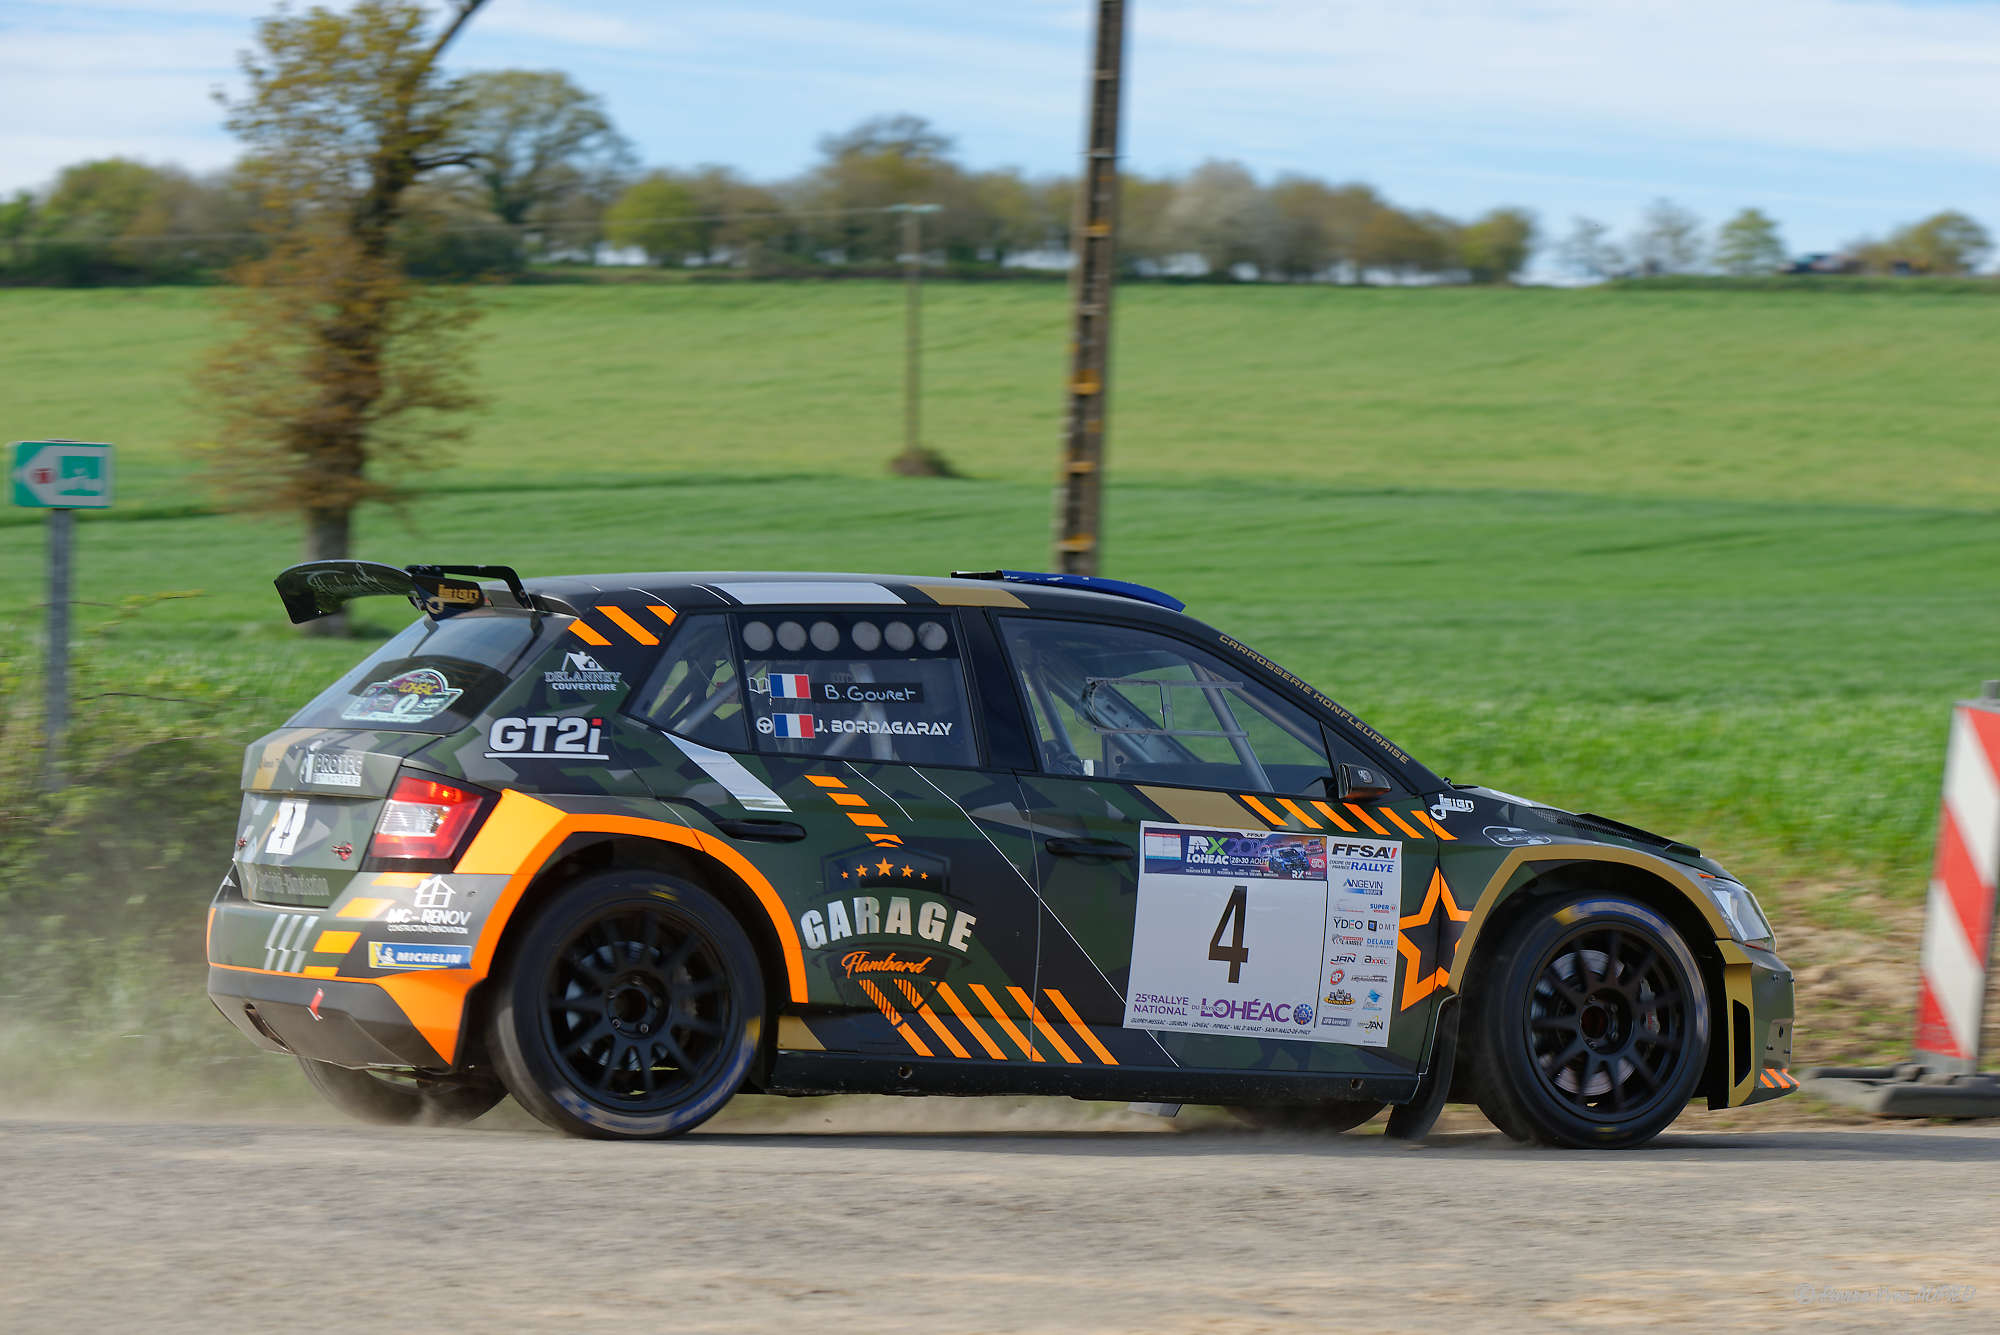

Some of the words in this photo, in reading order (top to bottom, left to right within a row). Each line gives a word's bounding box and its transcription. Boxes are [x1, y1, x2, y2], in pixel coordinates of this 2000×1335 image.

[1219, 634, 1313, 695] CARROSSERIE
[552, 682, 617, 691] COUVERTURE
[489, 716, 603, 754] GT2i
[815, 719, 828, 734] J.
[831, 719, 953, 736] BORDAGARAY
[1188, 835, 1228, 856] RX
[1332, 843, 1389, 859] FFSA
[1187, 853, 1229, 865] LOHEAC
[1351, 862, 1394, 873] RALLYE
[1343, 878, 1383, 889] ANGEVIN
[800, 896, 977, 953] GARAGE
[1208, 885, 1249, 984] 4
[396, 951, 462, 963] MICHELIN
[841, 951, 933, 979] Flambard
[1150, 994, 1189, 1006] RALLYE
[1133, 1004, 1188, 1016] NATIONAL
[1200, 998, 1292, 1023] LOHÉAC
